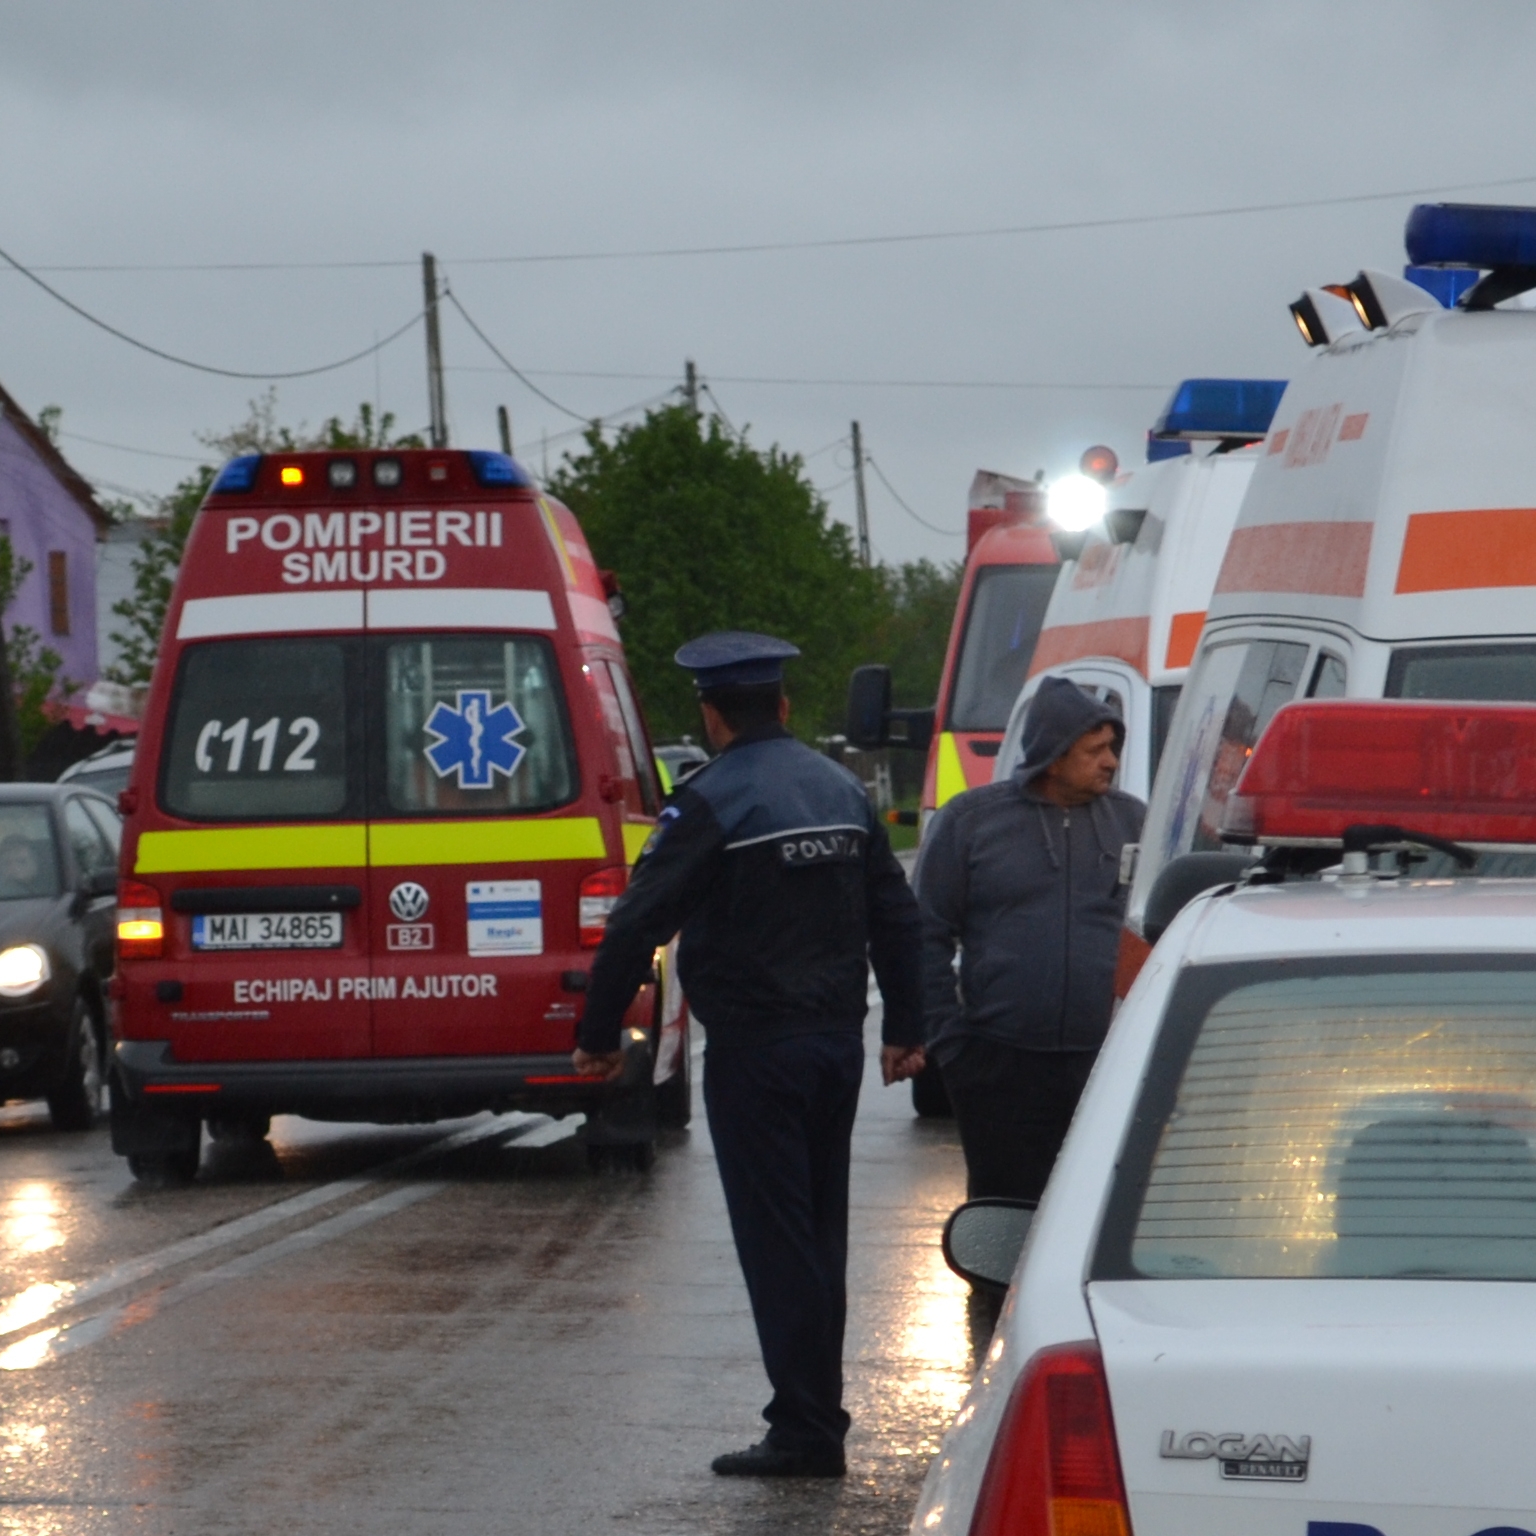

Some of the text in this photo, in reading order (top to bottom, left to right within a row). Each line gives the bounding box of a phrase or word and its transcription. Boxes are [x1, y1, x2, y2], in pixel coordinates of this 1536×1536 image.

[226, 511, 503, 553] POMPIERII
[281, 549, 447, 584] SMURD
[221, 716, 321, 772] 112
[210, 917, 247, 941] MAI
[259, 916, 333, 940] 34865
[398, 928, 423, 946] B2
[233, 974, 498, 1003] ECHIPAJ PRIM AJUTOR
[1160, 1430, 1311, 1462] LOGAN
